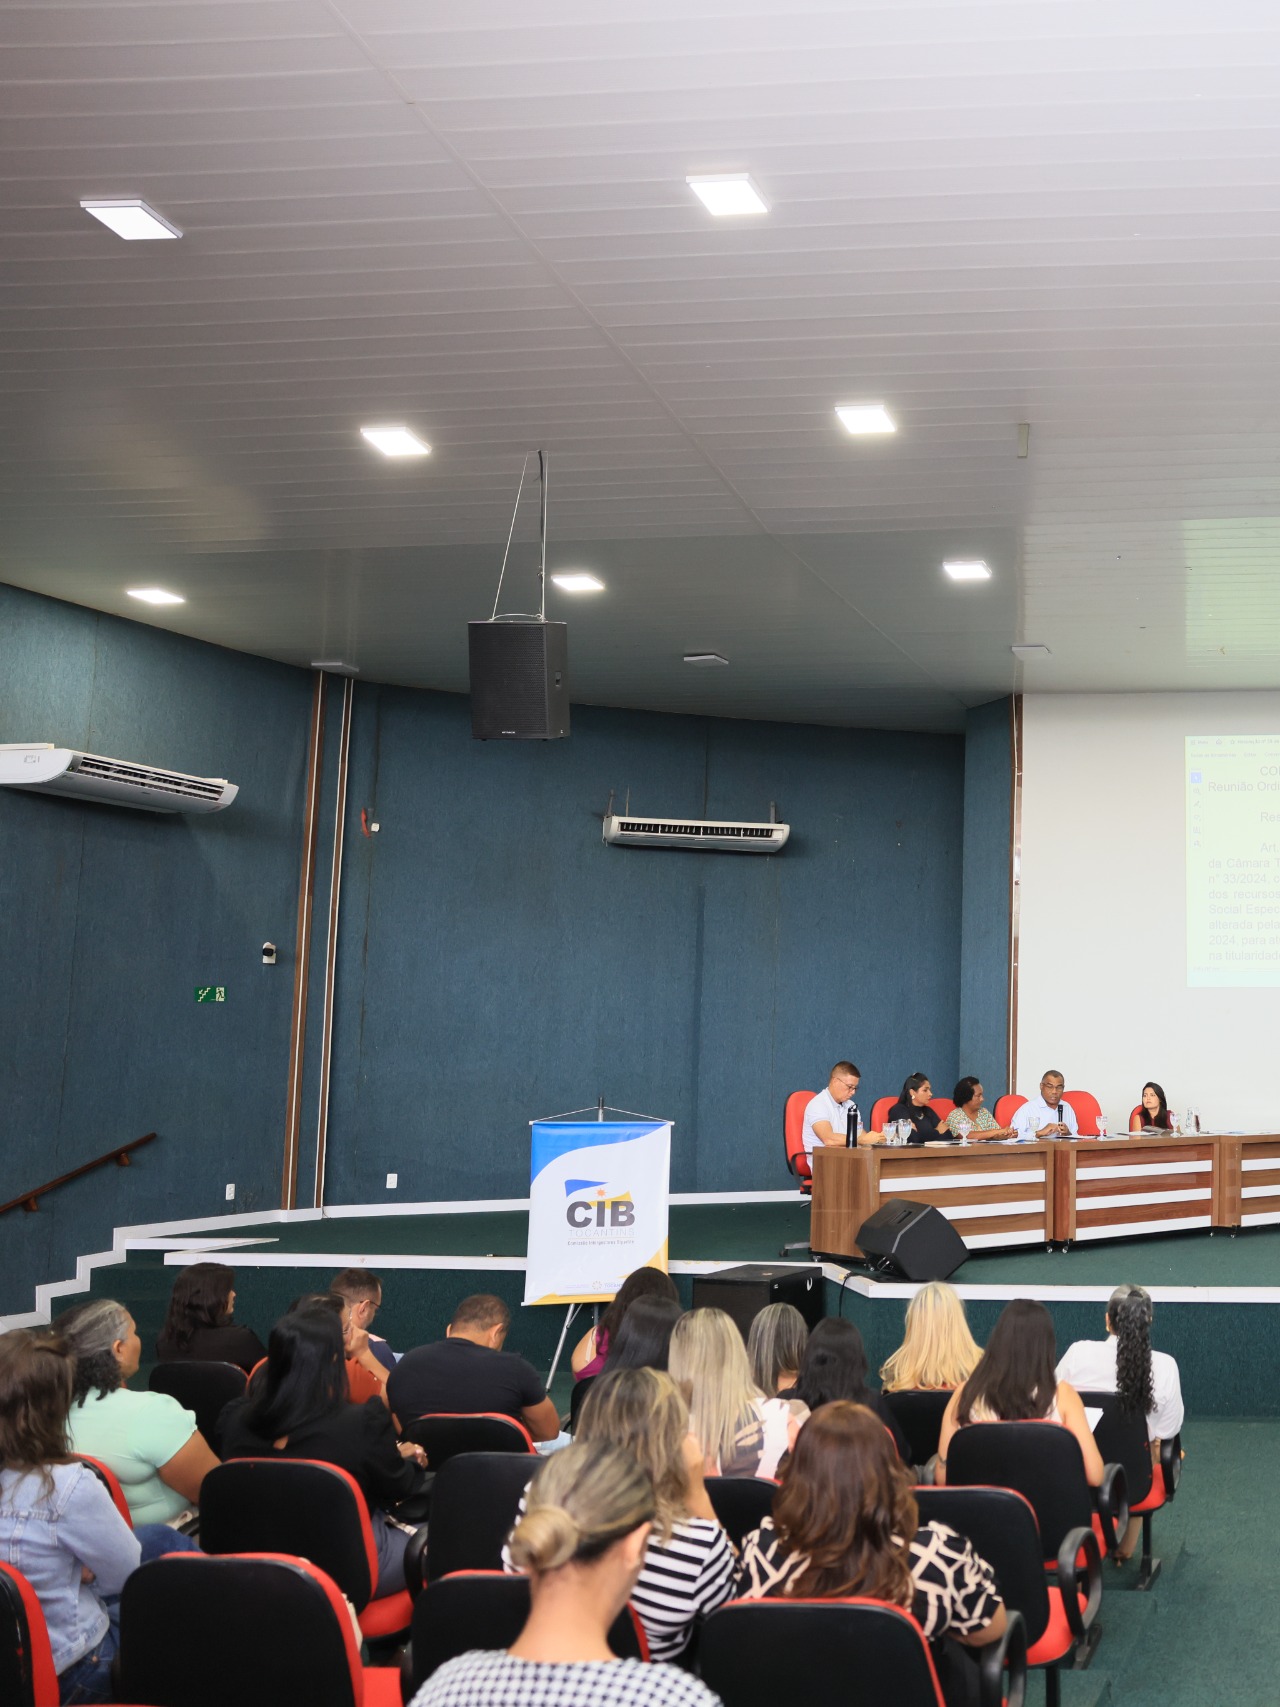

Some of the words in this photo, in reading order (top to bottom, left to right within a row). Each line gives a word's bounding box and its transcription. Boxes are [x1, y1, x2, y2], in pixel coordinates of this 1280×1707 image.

[1208, 781, 1253, 791] Reunião
[1208, 858, 1221, 868] da
[1226, 858, 1270, 868] Câmara
[1208, 889, 1228, 899] dos
[1209, 904, 1241, 913] Social
[1209, 920, 1252, 929] alterada
[1257, 920, 1280, 931] pela
[1241, 937, 1266, 946] para
[566, 1201, 635, 1228] CIB
[569, 1228, 635, 1237] TOCANTINS
